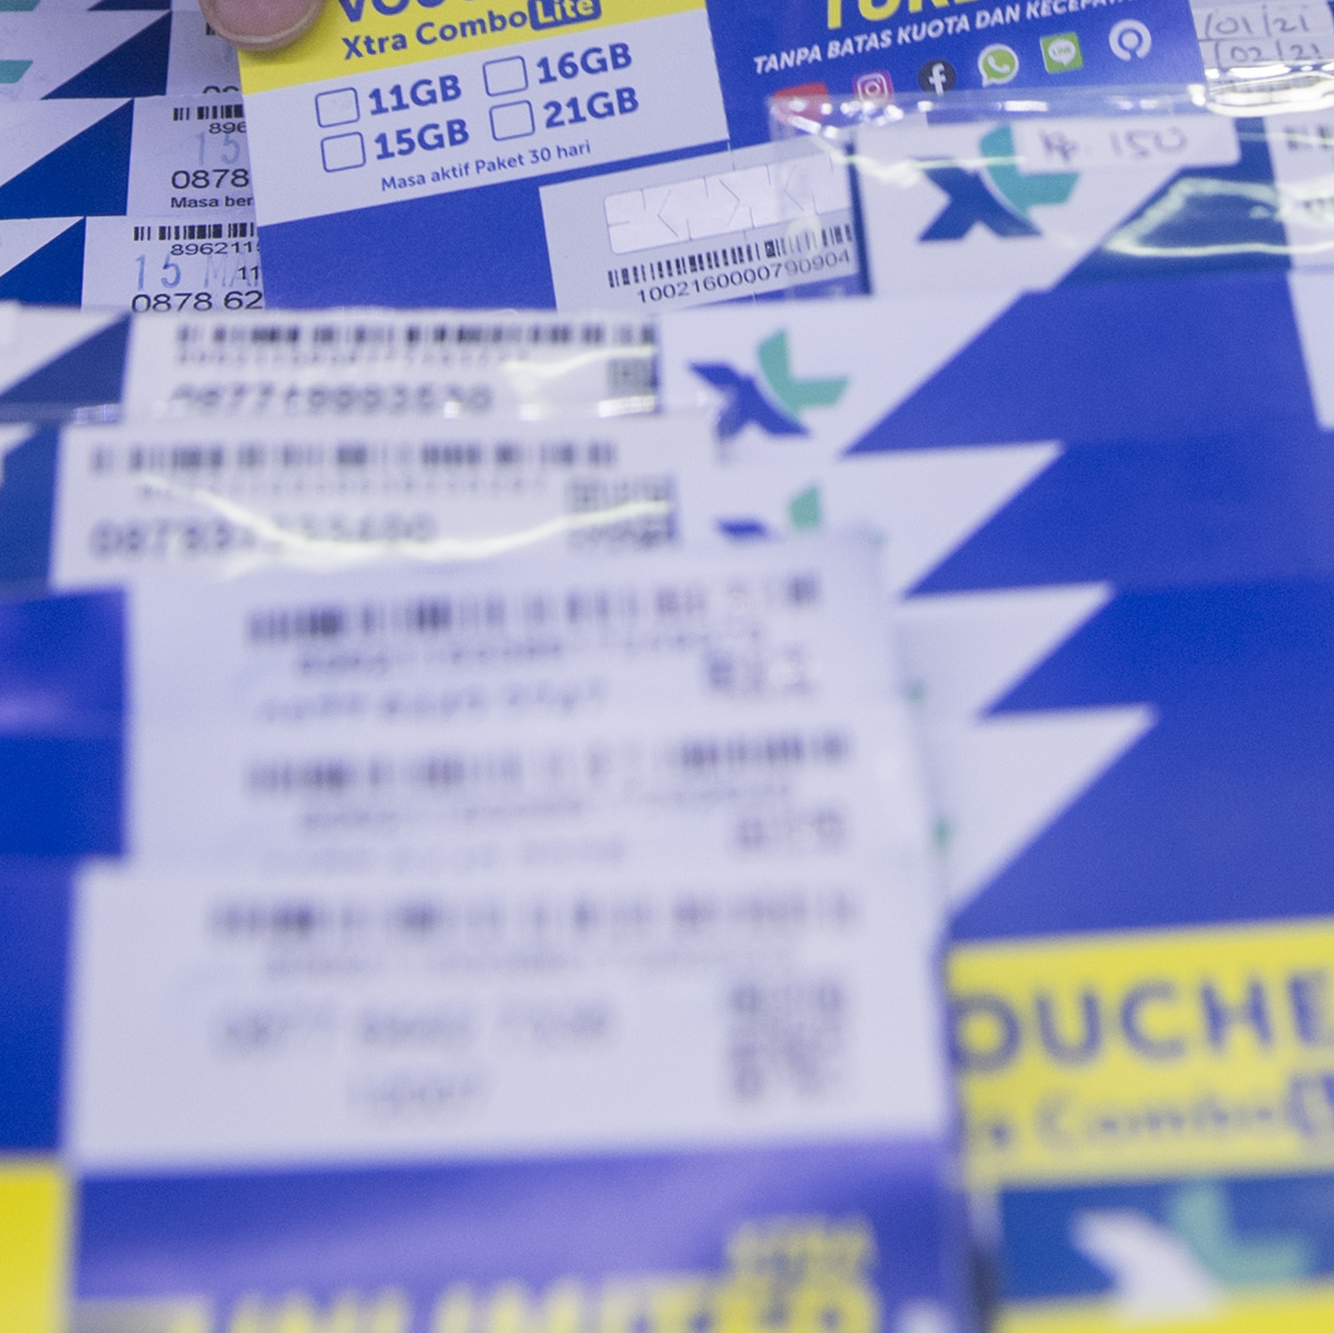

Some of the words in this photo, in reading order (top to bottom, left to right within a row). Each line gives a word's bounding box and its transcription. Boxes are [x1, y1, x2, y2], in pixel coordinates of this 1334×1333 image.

[341, 33, 409, 61] Xtra
[415, 8, 528, 47] Combo
[754, 43, 822, 75] TANPA
[827, 29, 893, 60] BATAS
[896, 14, 971, 47] KUOTA
[975, 3, 1021, 31] DAN
[367, 74, 463, 116] 11GB
[536, 42, 633, 84] 16GB
[373, 118, 471, 161] 15GB
[542, 86, 641, 130] 21GB
[170, 168, 250, 190] 0878
[380, 168, 427, 192] Masa
[430, 160, 471, 184] aktif
[475, 152, 526, 175] Paket
[529, 146, 553, 164] 30
[557, 139, 593, 159] hari
[170, 196, 219, 209] Masa
[131, 292, 214, 315] 0878
[223, 290, 264, 311] 62
[636, 248, 853, 304] 1002160000790904
